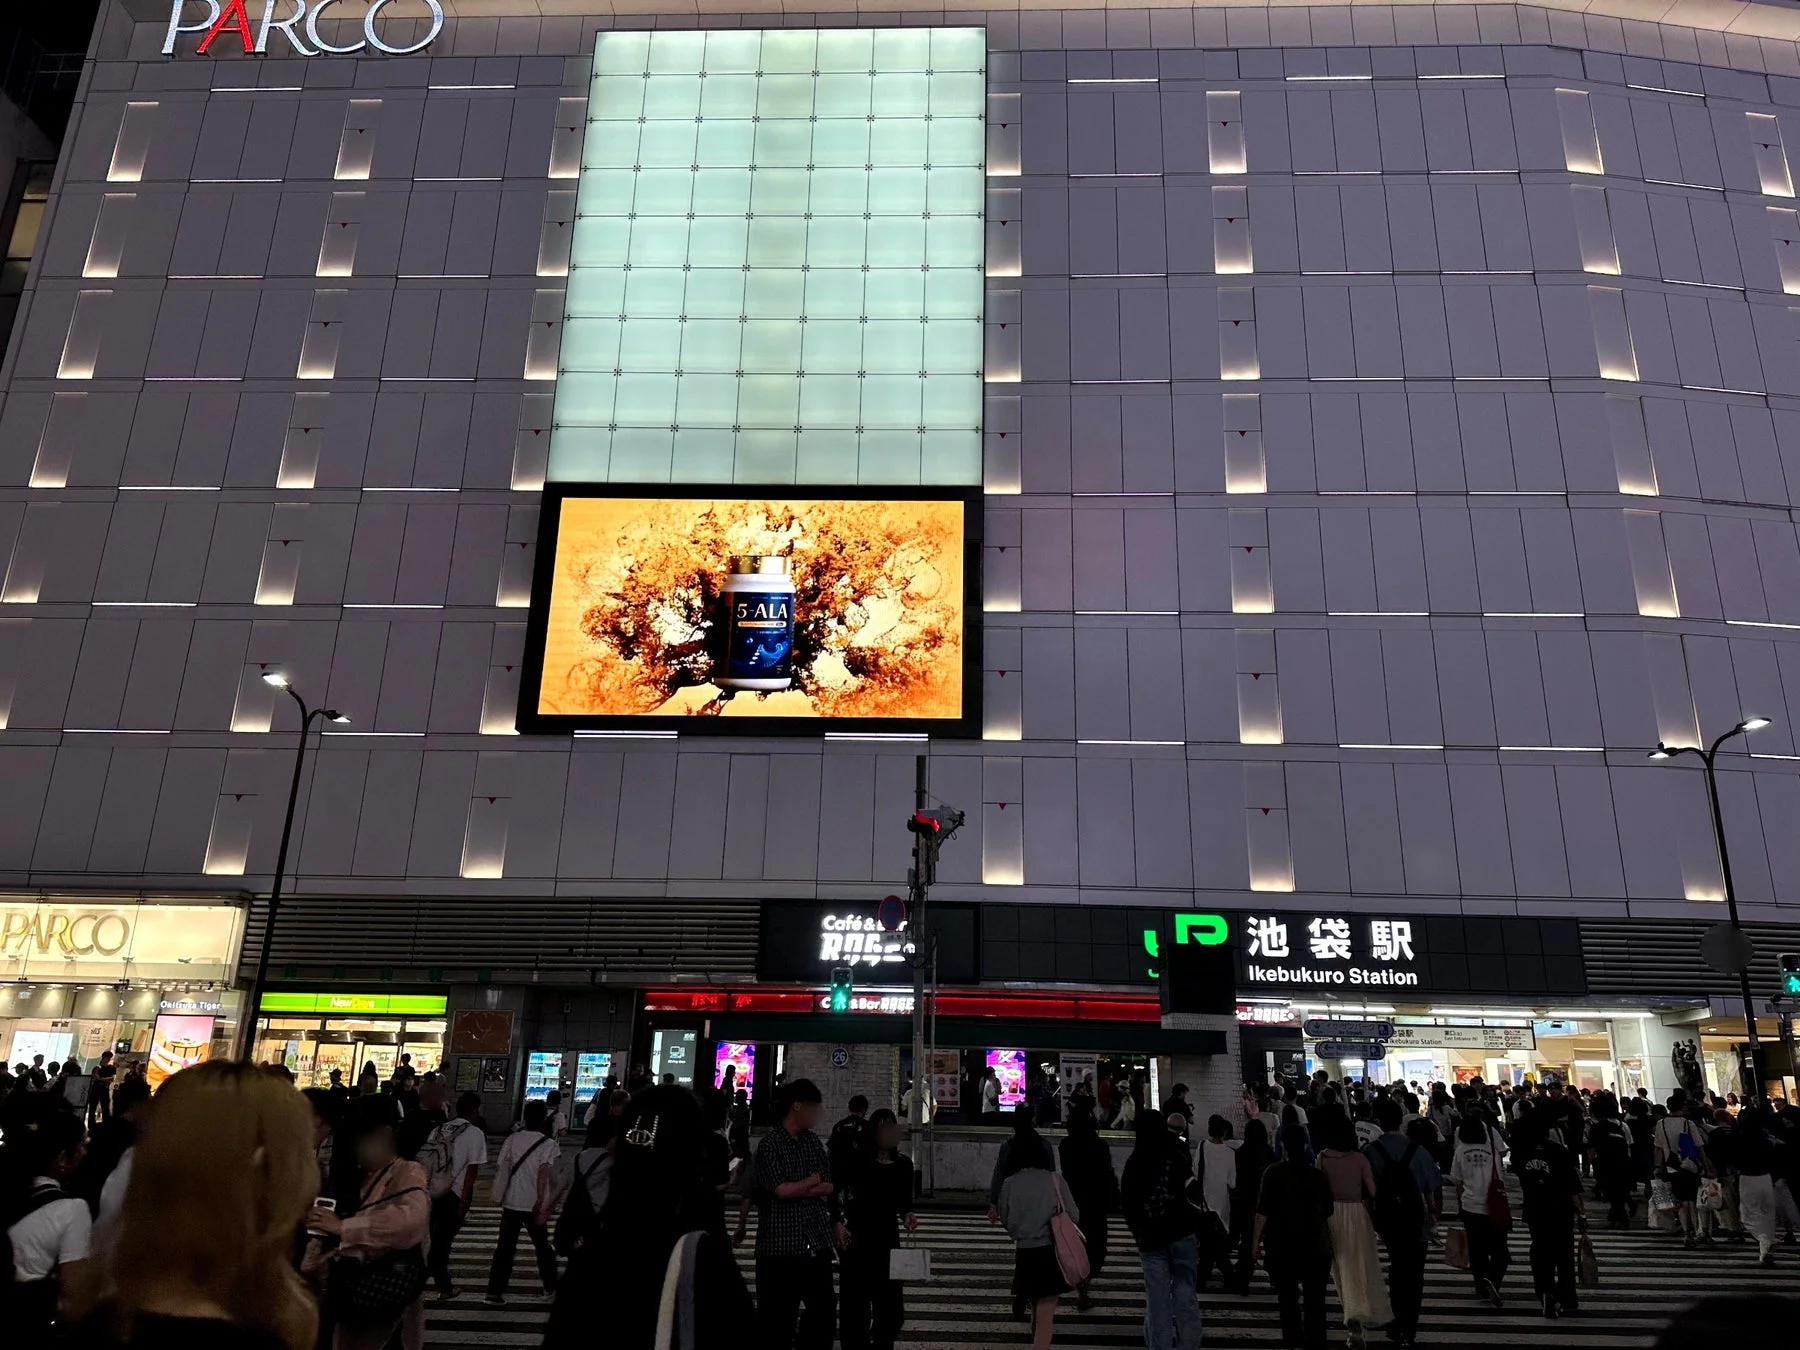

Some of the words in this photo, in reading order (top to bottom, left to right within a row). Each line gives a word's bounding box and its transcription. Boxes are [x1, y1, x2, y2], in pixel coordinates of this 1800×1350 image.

[161, 0, 444, 56] PARCO
[737, 603, 788, 619] 5-ALA
[823, 914, 862, 931] Café
[864, 917, 876, 931] &
[0, 912, 130, 956] PARCO
[1247, 916, 1414, 961] 池袋駅
[1249, 965, 1345, 984] Ikebukuro
[1350, 967, 1418, 985] Station
[160, 1000, 197, 1009] Onitsuka
[199, 1001, 221, 1011] Tiger
[860, 998, 880, 1010] Bar
[834, 1051, 846, 1062] 26
